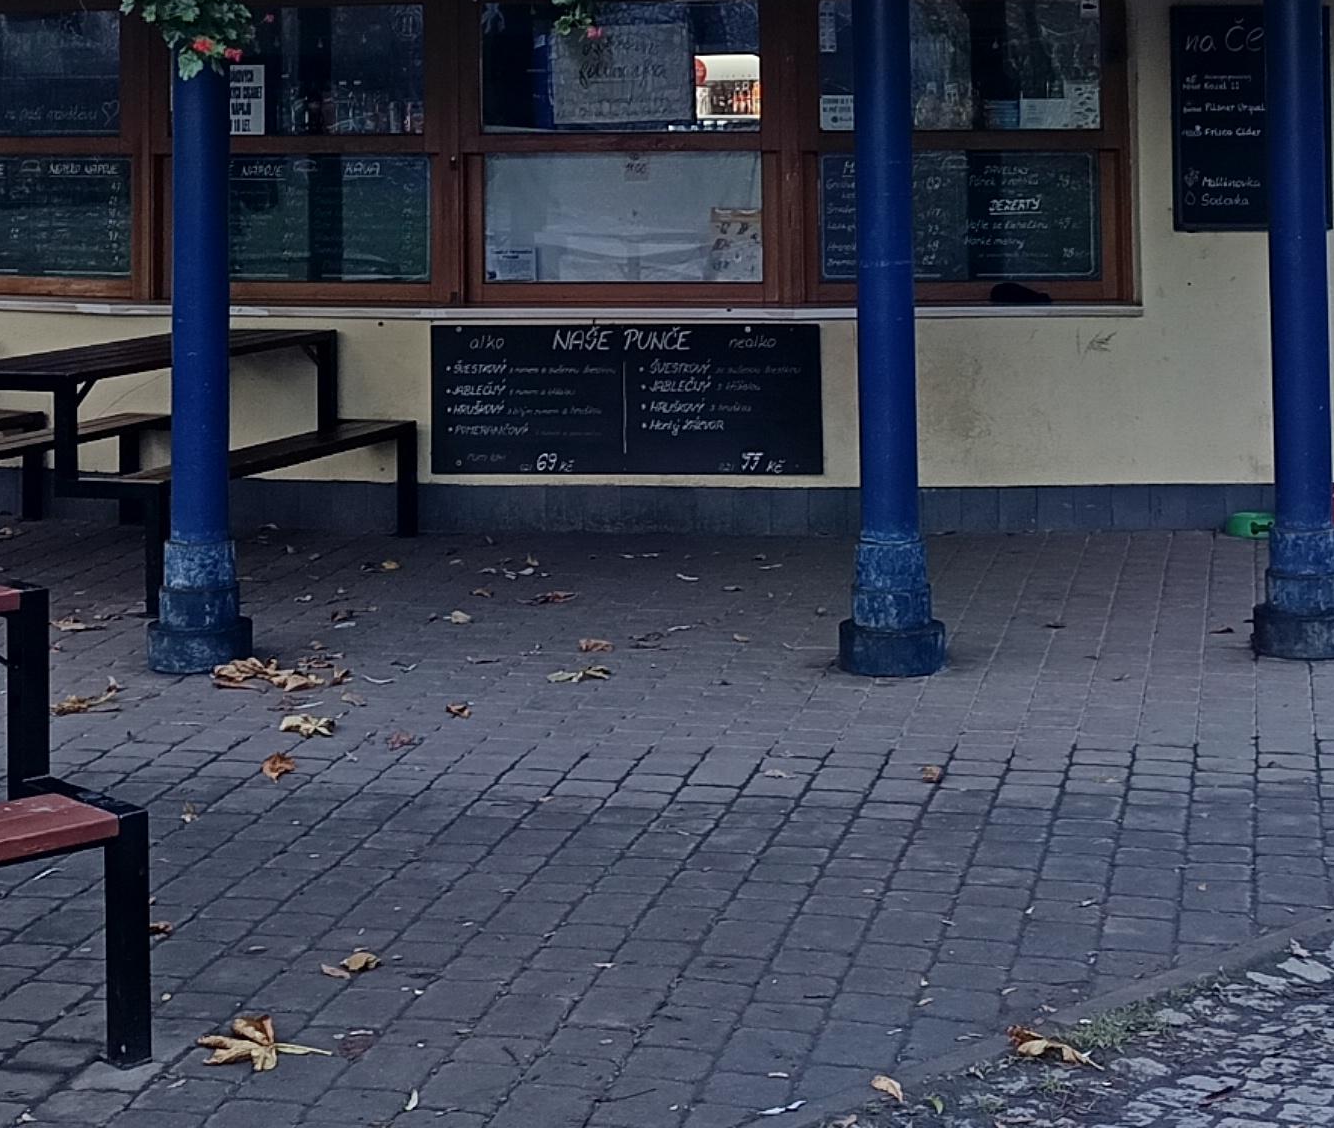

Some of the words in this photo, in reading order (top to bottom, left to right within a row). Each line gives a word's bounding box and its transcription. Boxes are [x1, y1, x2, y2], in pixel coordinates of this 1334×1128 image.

[1225, 17, 1265, 52] Če
[469, 334, 505, 350] alko
[551, 326, 614, 351] NAŠE
[623, 326, 693, 351] PUNČE
[728, 334, 777, 349] nealko
[649, 358, 712, 375] ŠVESTKOVÝ
[648, 375, 712, 393] JABLEČNÝ
[649, 397, 706, 413] HRUŠKOVÝ
[536, 453, 558, 471] 69
[765, 459, 786, 473] Kč
